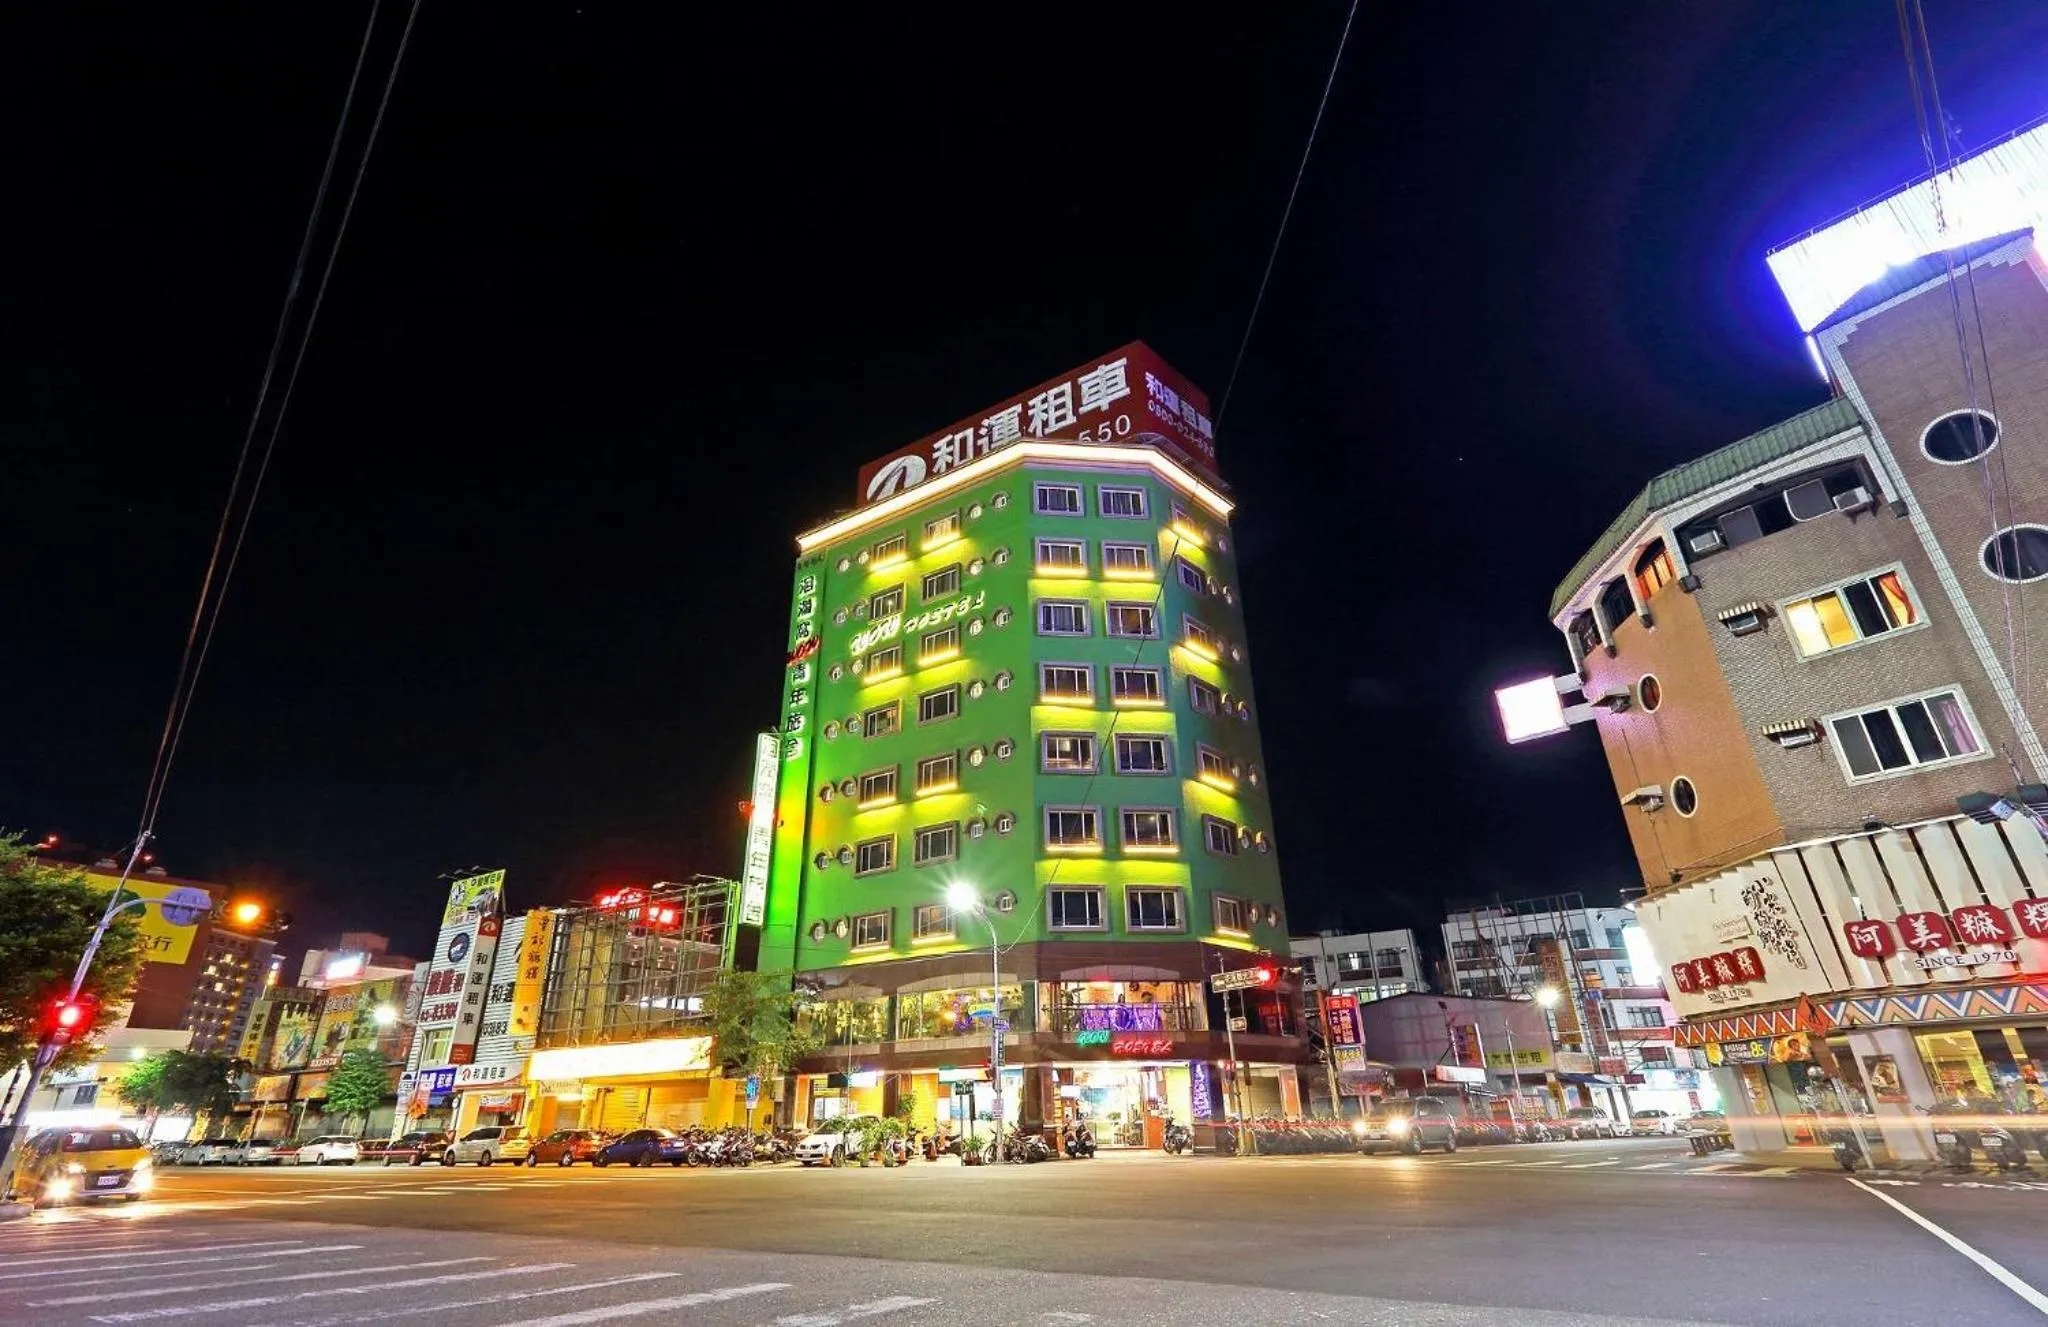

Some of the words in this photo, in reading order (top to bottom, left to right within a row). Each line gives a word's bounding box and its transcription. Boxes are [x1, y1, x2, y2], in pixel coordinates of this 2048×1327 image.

[932, 357, 1131, 474] 和運租車
[462, 952, 489, 1025] 和運租車
[1914, 955, 1967, 969] SINCE
[1973, 950, 2016, 964] 1970
